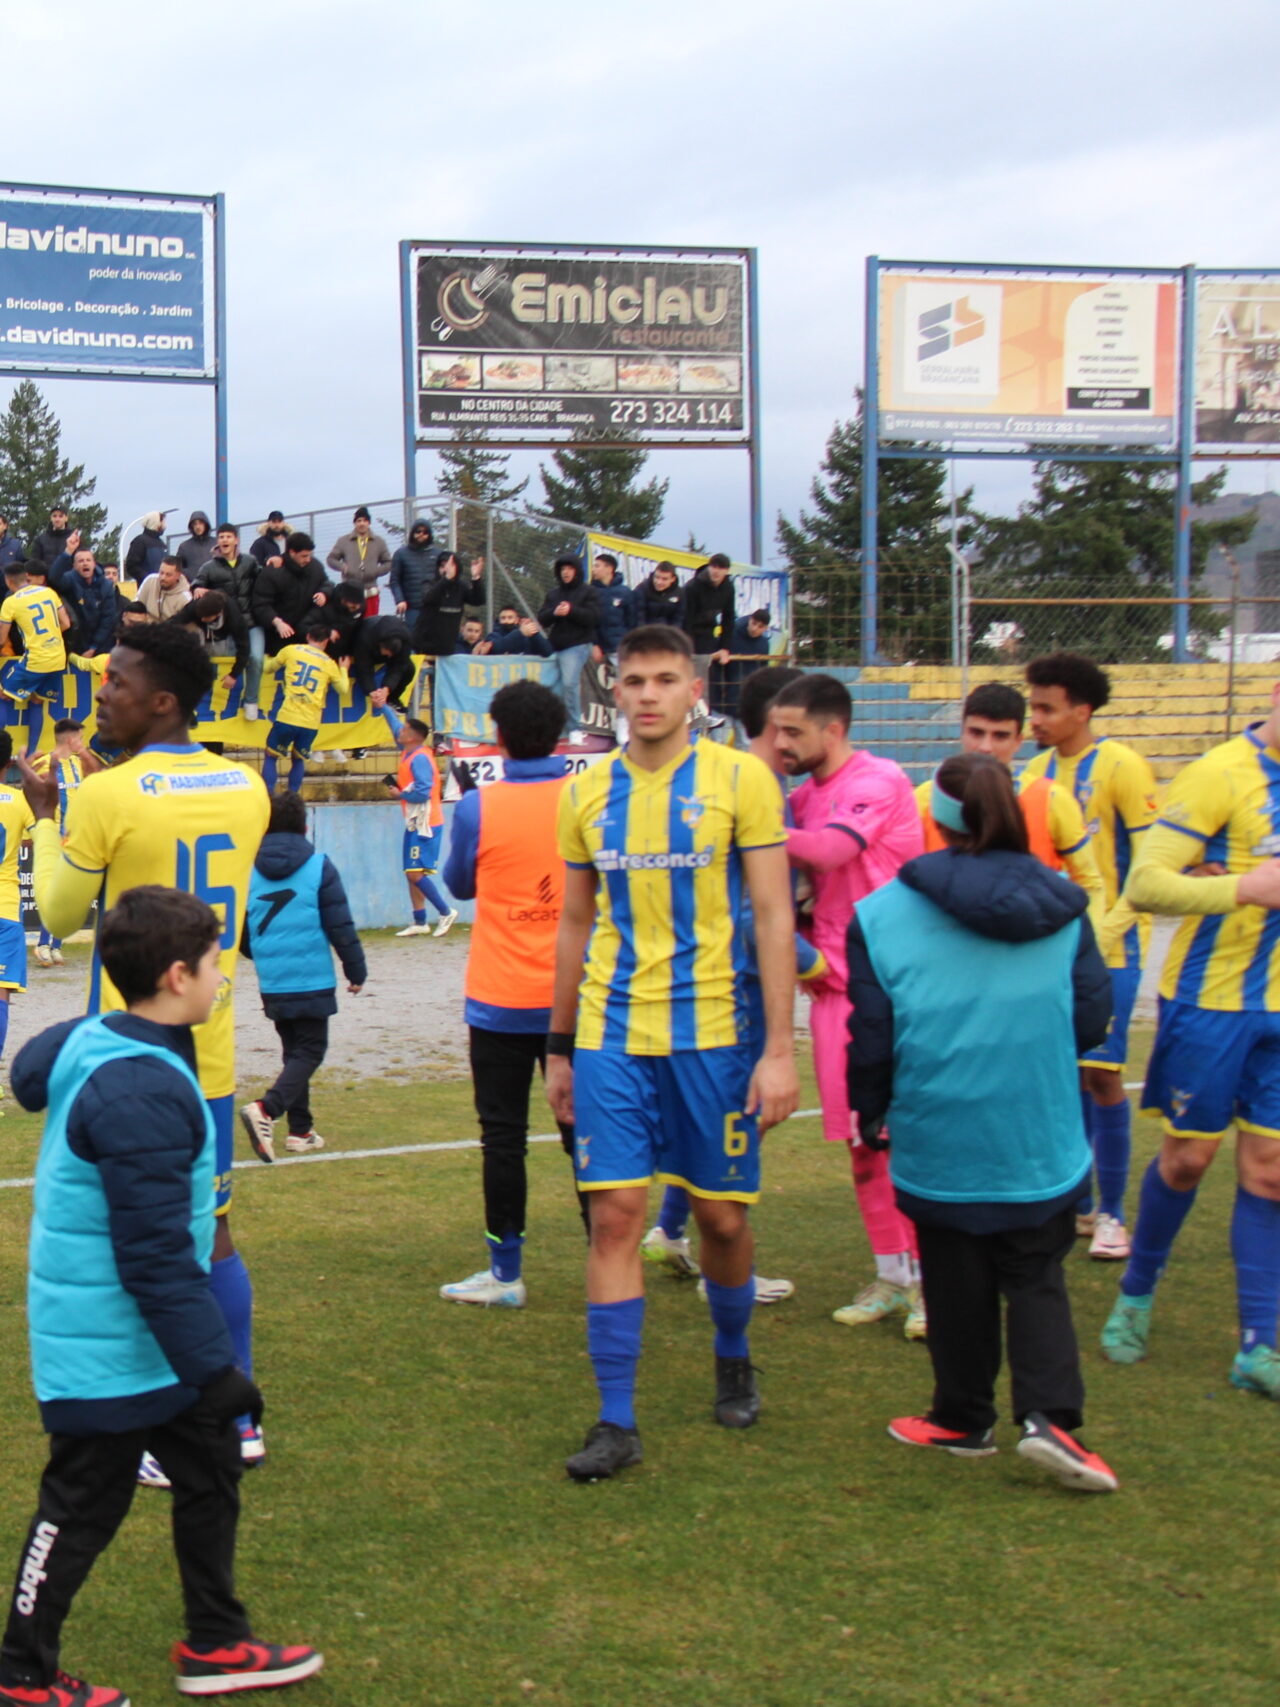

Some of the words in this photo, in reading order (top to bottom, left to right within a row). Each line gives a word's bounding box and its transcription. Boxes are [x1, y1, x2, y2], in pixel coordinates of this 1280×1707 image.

[89, 268, 119, 280] poder
[122, 269, 134, 279] da
[136, 270, 182, 282] inovação
[7, 298, 63, 313] Bricolage
[75, 301, 138, 316] Decoração
[150, 305, 192, 317] Jardim
[461, 400, 474, 410] NO
[477, 400, 513, 411] CENTRO
[515, 401, 528, 411] DA
[530, 401, 563, 411] CIDADE
[610, 401, 647, 423] 273
[653, 401, 691, 423] 324
[696, 402, 733, 424] 114
[27, 600, 58, 635] 27
[291, 661, 323, 693] 36
[468, 662, 542, 688] BEER
[443, 709, 497, 739] FRE
[724, 1111, 748, 1157] 6
[16, 1521, 59, 1616] umbro
